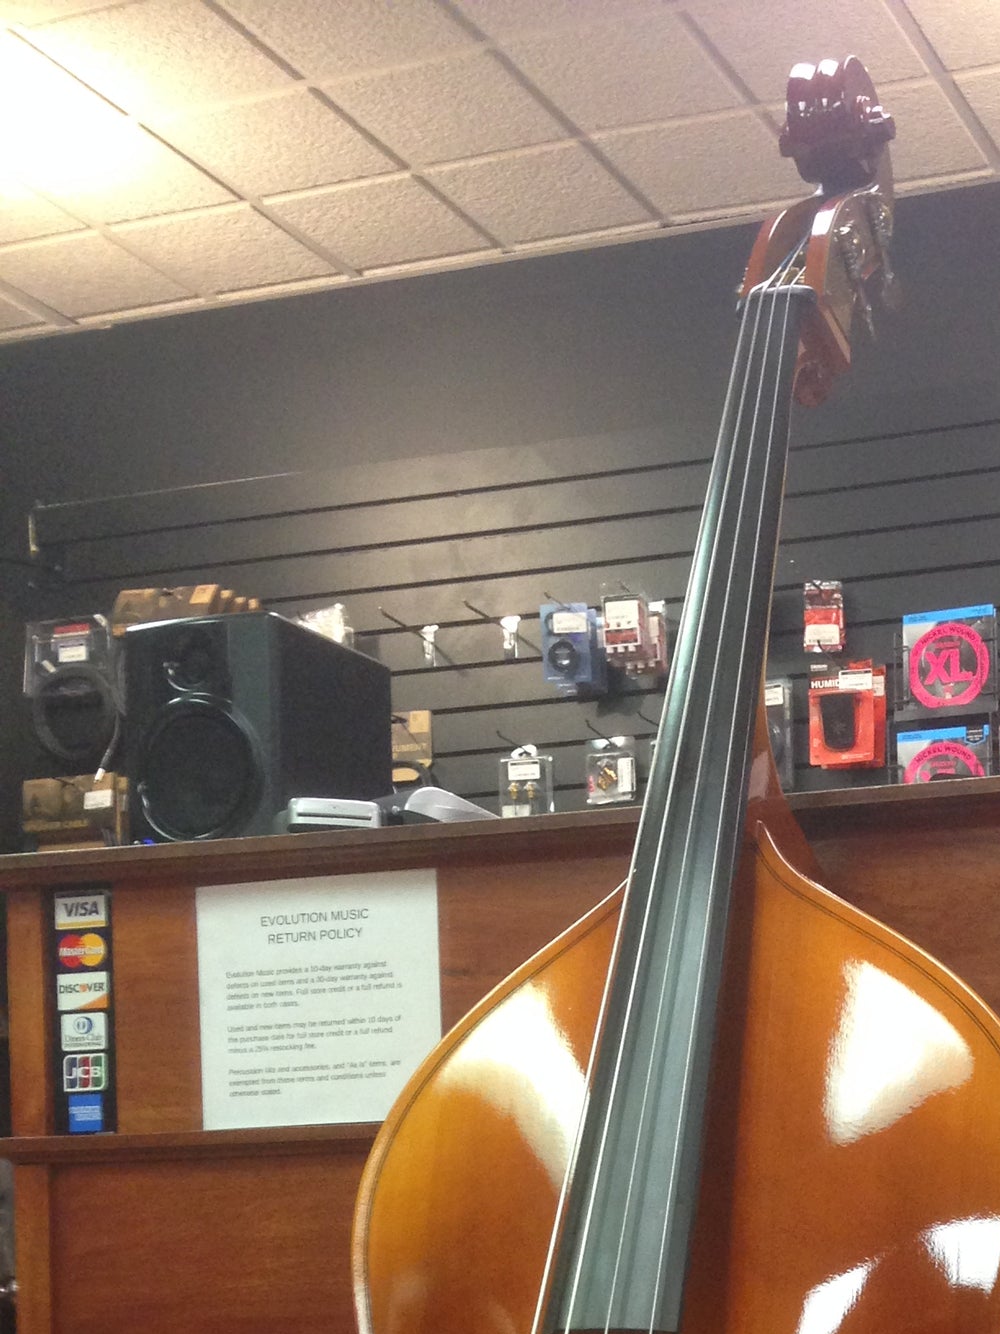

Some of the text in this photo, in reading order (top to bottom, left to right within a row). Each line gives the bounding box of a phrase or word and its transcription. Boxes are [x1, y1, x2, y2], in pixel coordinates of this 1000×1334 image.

[921, 627, 948, 645] NICKEL
[950, 627, 976, 641] WOUND
[924, 649, 976, 685] XL
[916, 746, 972, 763] NICKEL WOUND
[63, 901, 99, 917] VISA
[261, 908, 369, 927] EVOLUTION MUSIC
[268, 927, 362, 944] RETURN POLICY
[59, 983, 104, 993] DISCOVER
[65, 1067, 100, 1078] JCB
